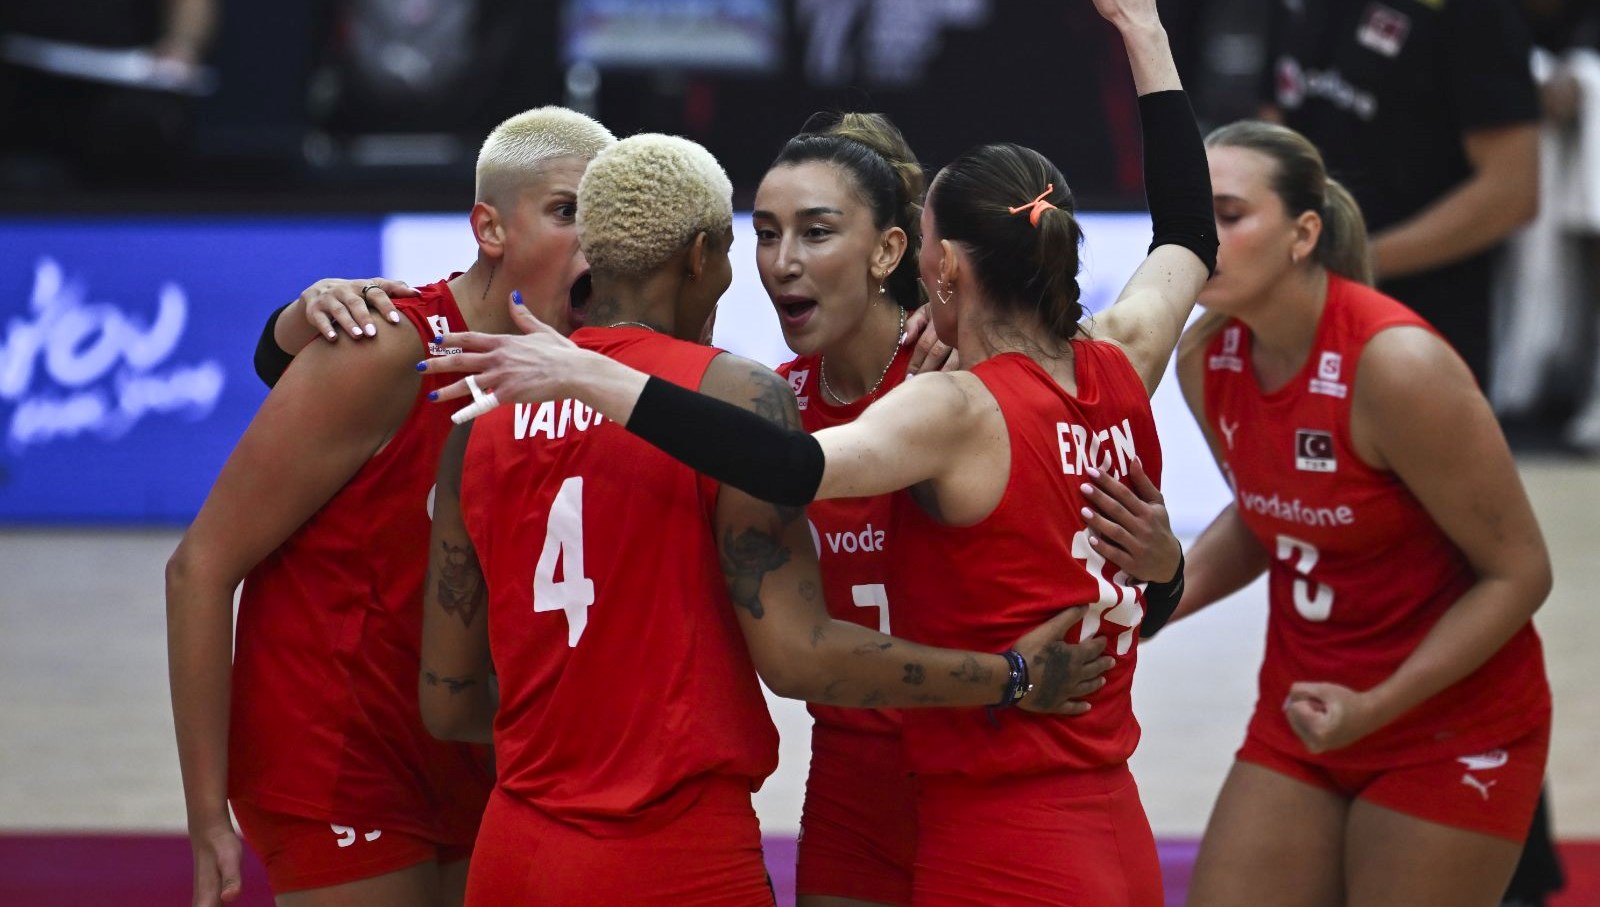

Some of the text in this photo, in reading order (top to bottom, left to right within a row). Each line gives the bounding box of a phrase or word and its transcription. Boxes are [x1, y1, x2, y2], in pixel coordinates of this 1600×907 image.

[1240, 491, 1355, 527] vodafone
[533, 476, 594, 648] 4
[1276, 533, 1335, 623] 3
